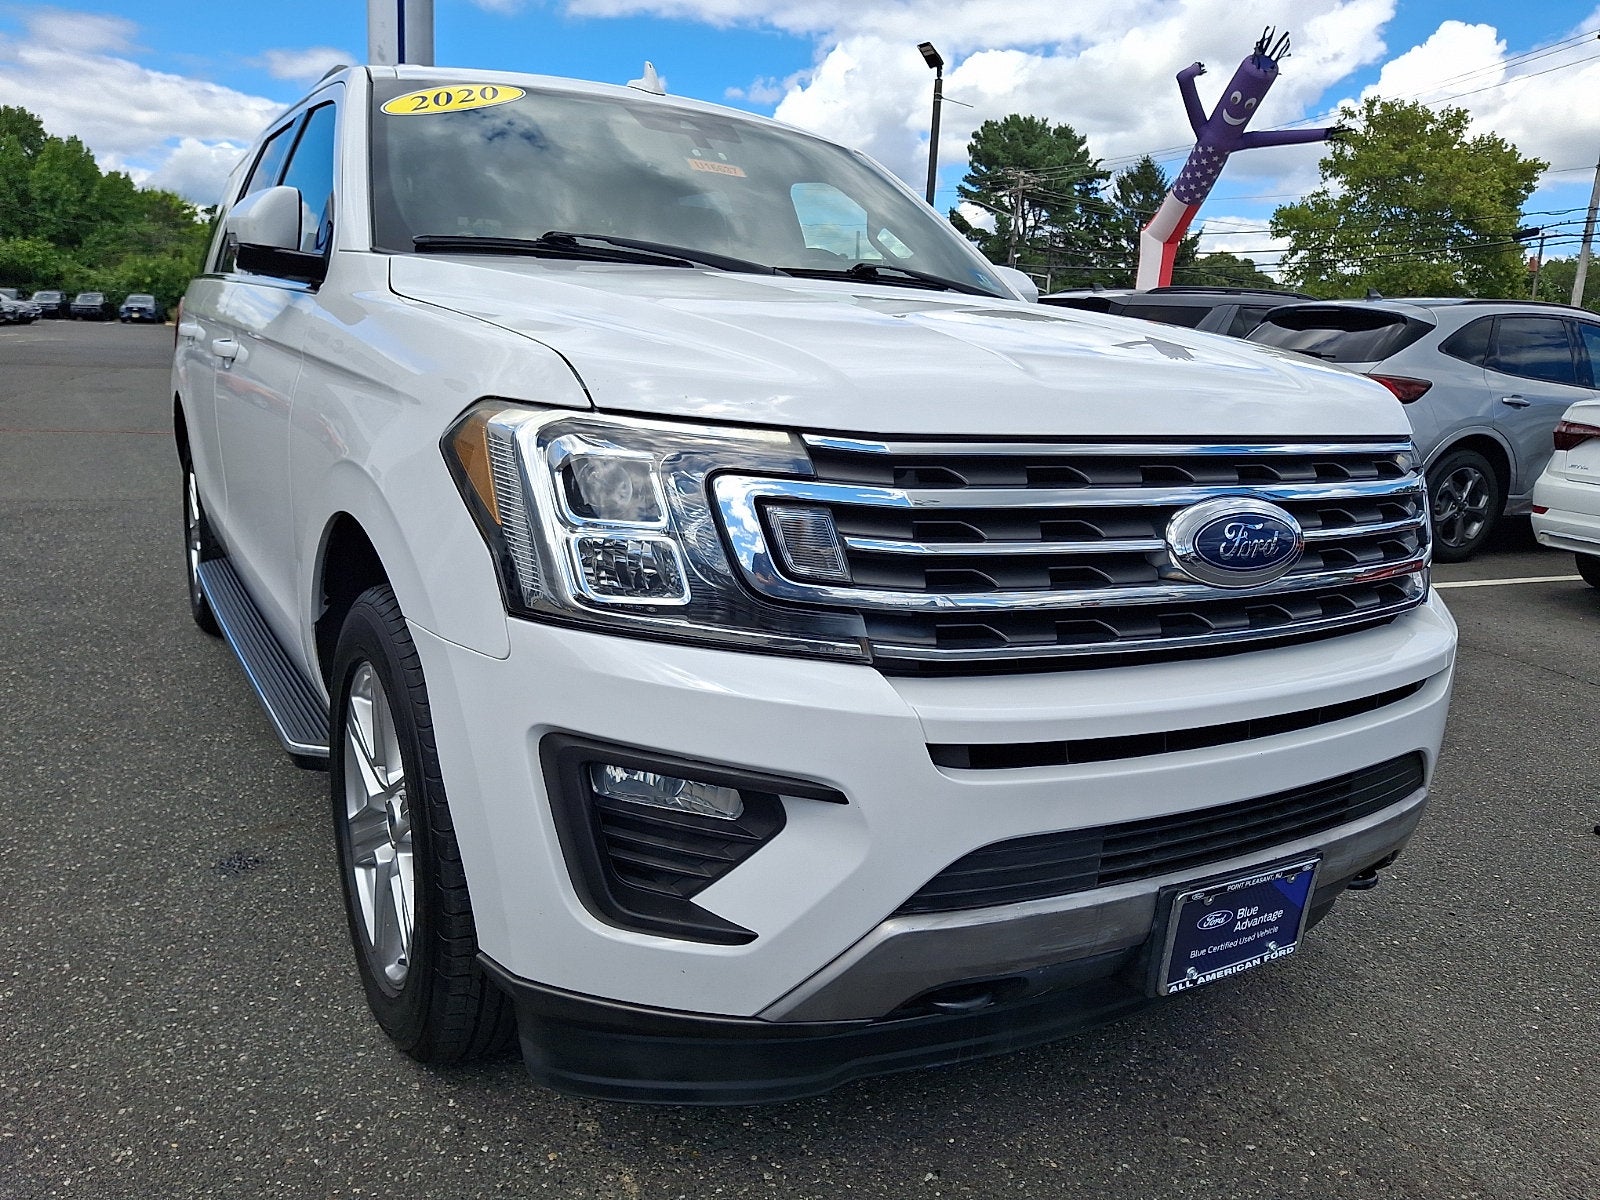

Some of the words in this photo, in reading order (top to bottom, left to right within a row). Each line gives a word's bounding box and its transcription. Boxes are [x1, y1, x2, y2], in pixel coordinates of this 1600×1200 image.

[410, 86, 498, 111] 2020
[1219, 522, 1279, 561] Ford
[1226, 883, 1244, 892] POINT
[1203, 913, 1227, 928] Ford
[1233, 909, 1284, 933] Advantage
[1236, 905, 1259, 920] Blue
[1189, 950, 1207, 959] Blue
[1207, 939, 1238, 954] Certified
[1239, 934, 1256, 945] Used
[1256, 925, 1279, 939] Vehicle
[1168, 980, 1194, 994] ALL
[1196, 957, 1261, 985] AMERICAN
[1263, 946, 1295, 963] FORD
